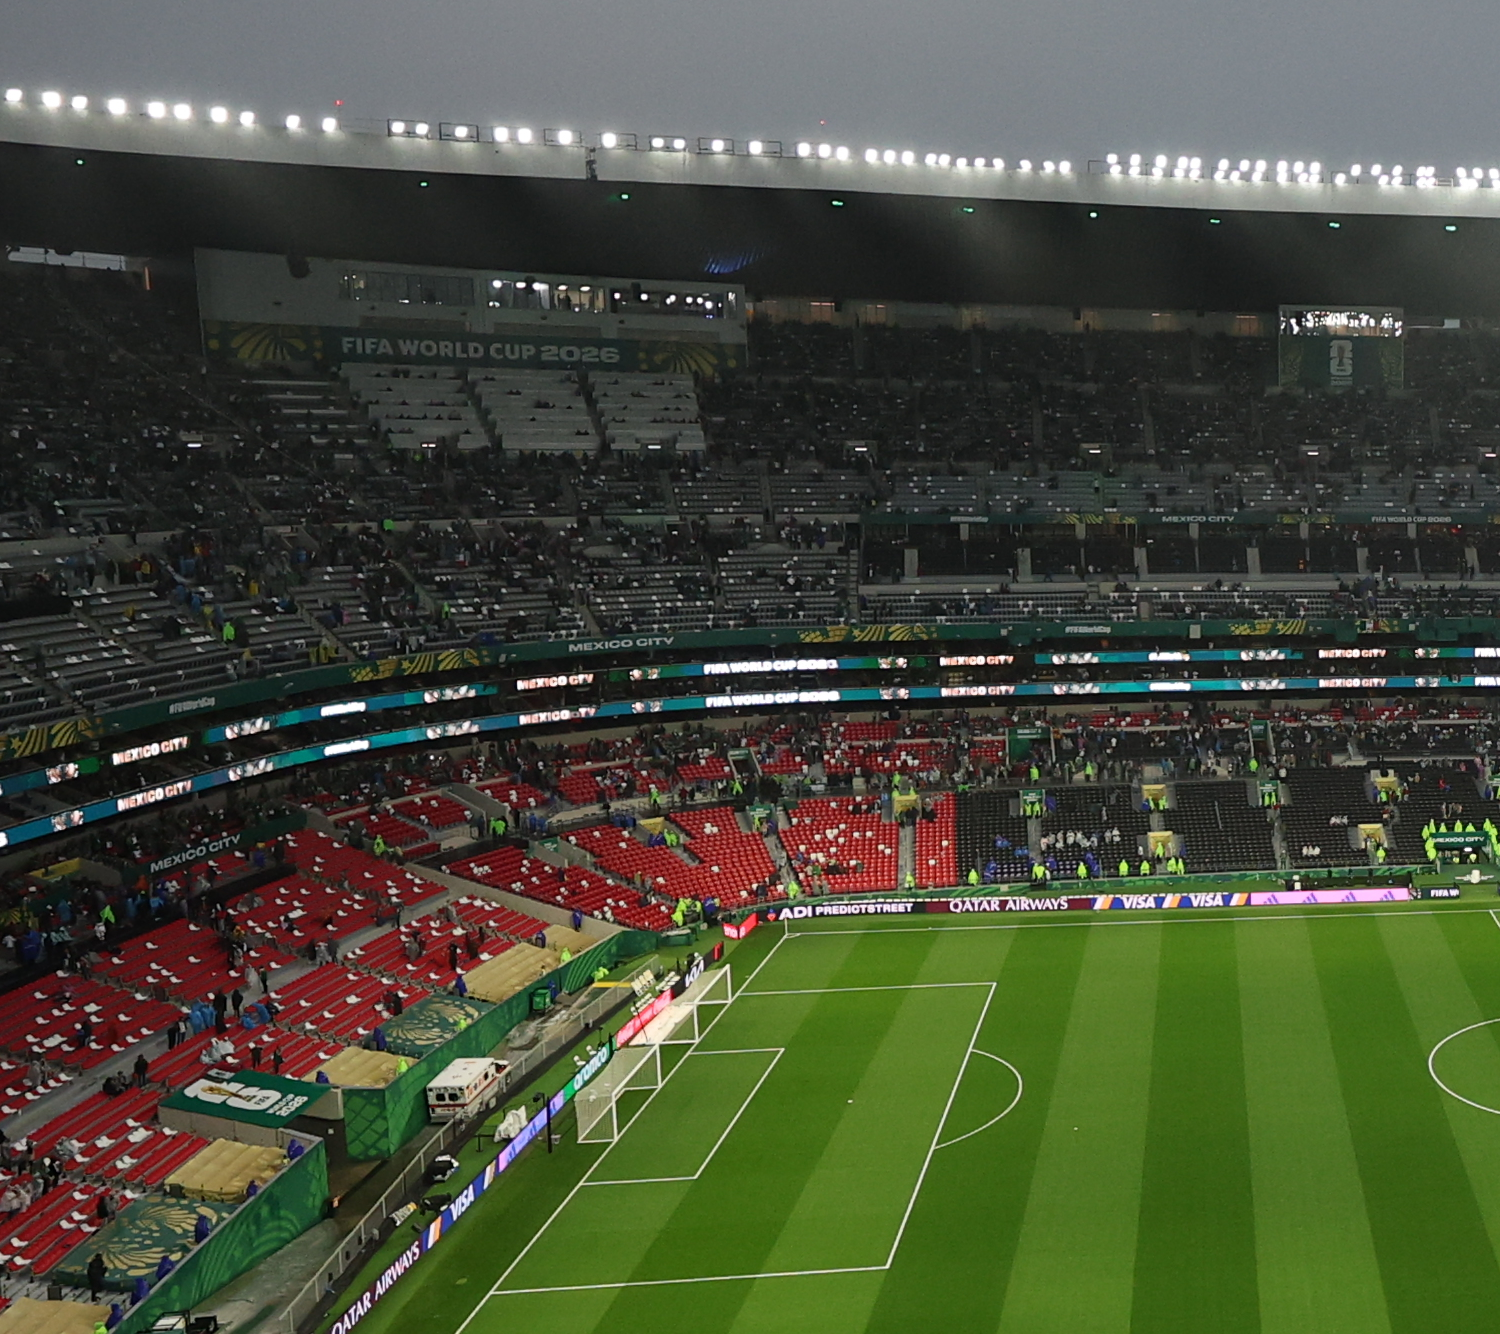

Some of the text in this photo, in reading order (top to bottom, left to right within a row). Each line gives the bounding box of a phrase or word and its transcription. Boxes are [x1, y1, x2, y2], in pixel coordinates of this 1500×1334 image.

[342, 337, 620, 363] FIFA WORLD CUP 2026
[1161, 515, 1206, 523] MEXICO
[568, 636, 675, 653] MEXICO CITY
[112, 736, 189, 765] MEXICO CITY
[117, 780, 192, 812] MEXICO CITY
[150, 833, 241, 873] MEXICO CITY
[949, 898, 1068, 912] QATAR AIRWAYS
[1122, 893, 1224, 909] VISA VISA
[1431, 888, 1448, 898] FIFA
[779, 903, 913, 920] ADI PREDICTSTREET
[573, 1046, 608, 1090] aramco
[450, 1183, 474, 1222] VISA
[374, 1240, 420, 1301] AIRWAYS
